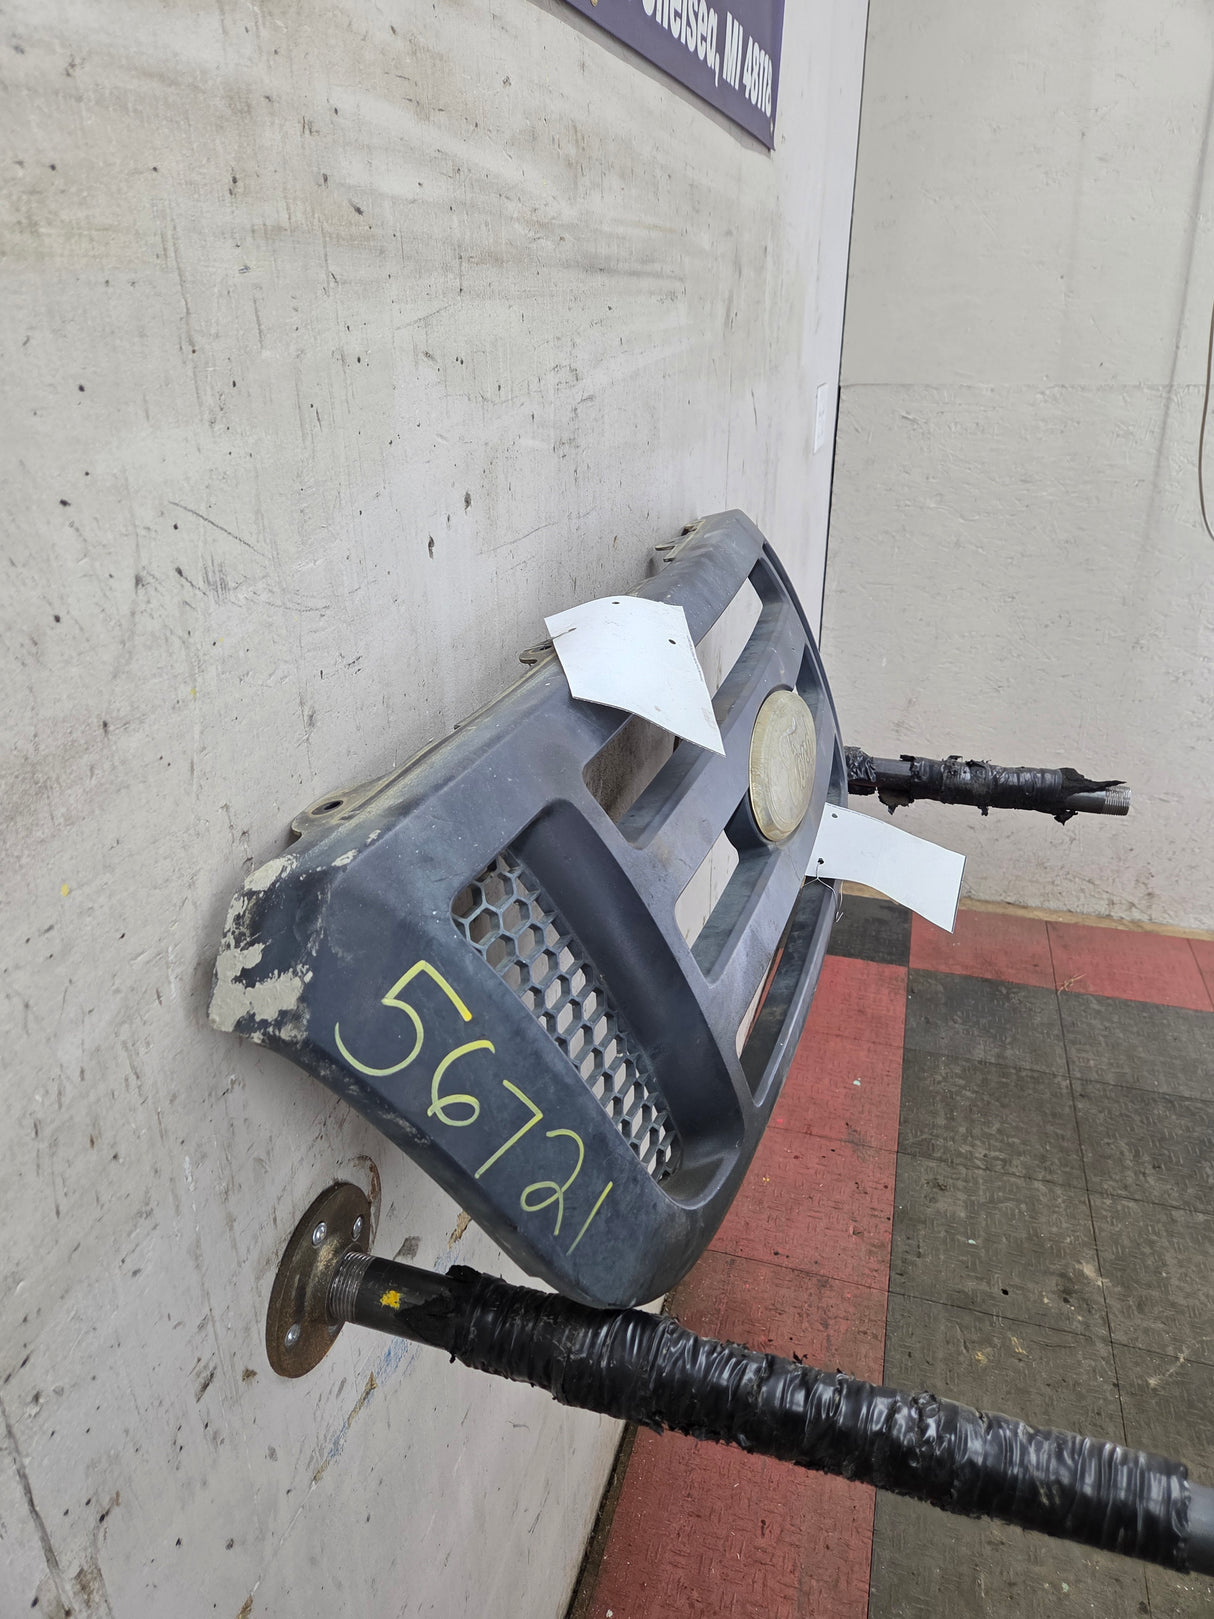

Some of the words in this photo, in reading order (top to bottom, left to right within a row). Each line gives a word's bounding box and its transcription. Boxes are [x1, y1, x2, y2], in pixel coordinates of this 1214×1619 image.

[642, 0, 720, 88] elsea,
[722, 11, 744, 91] MI
[742, 35, 773, 118] 48118
[335, 959, 614, 1256] 56721
